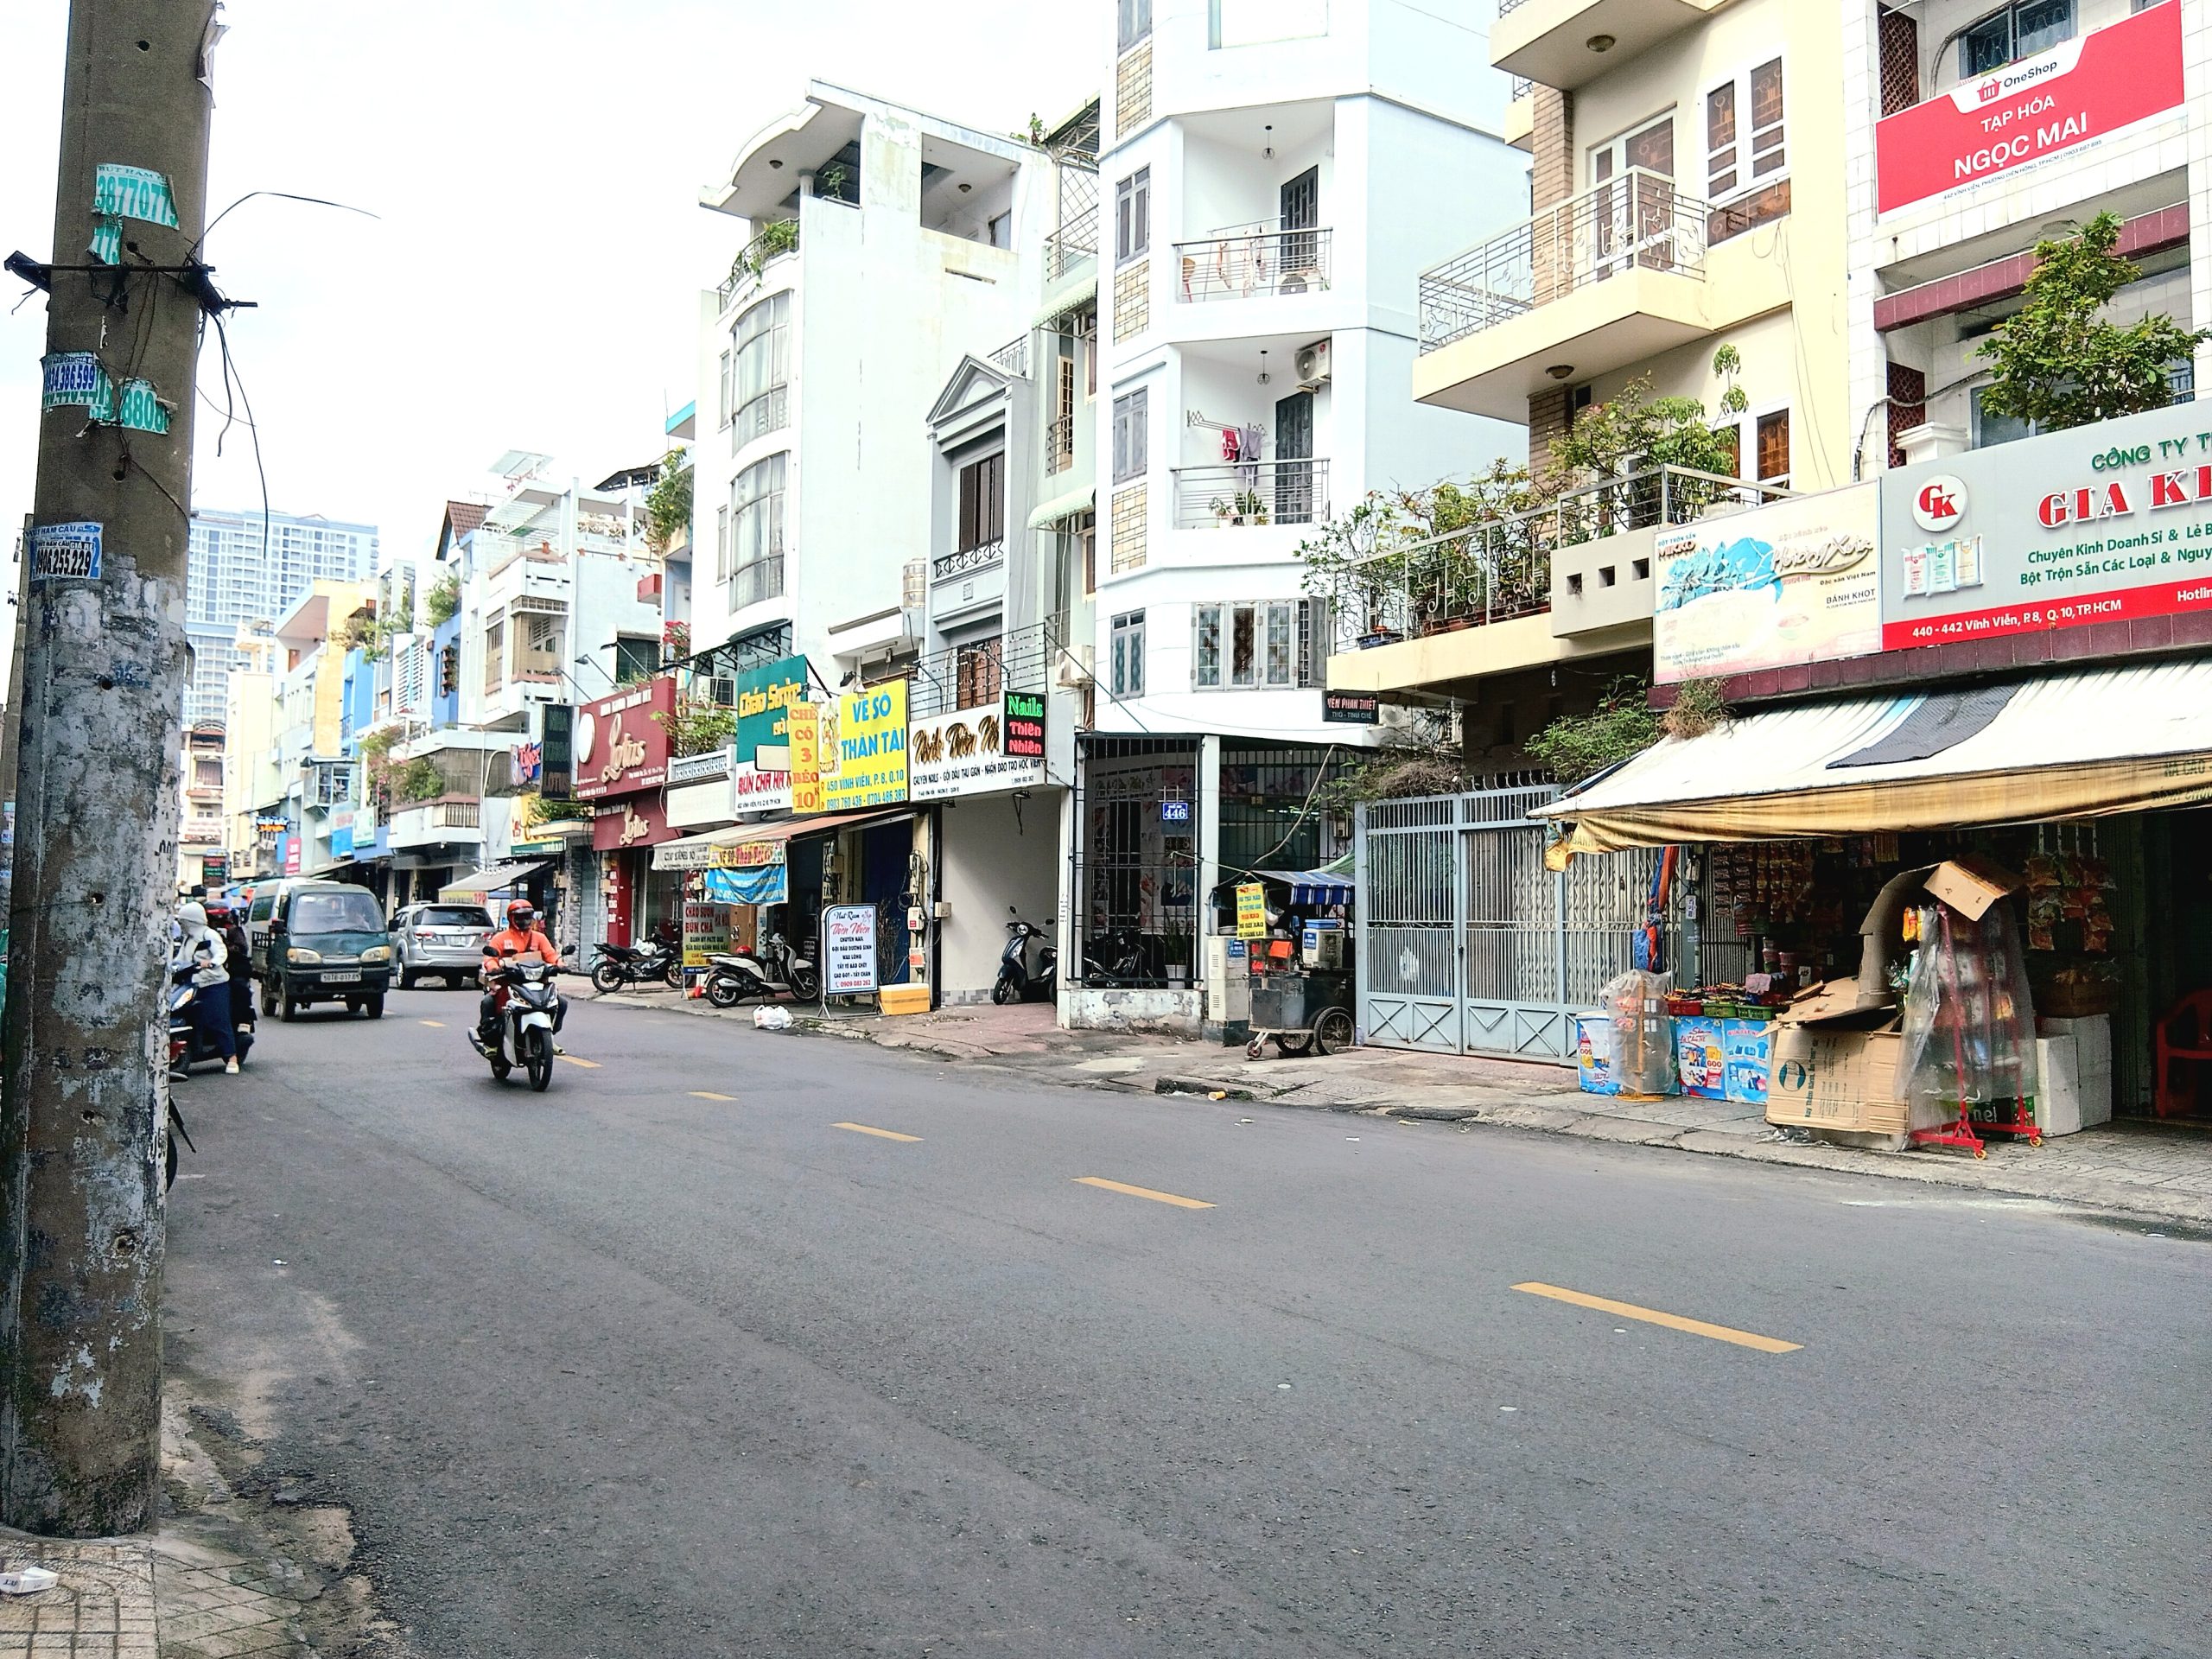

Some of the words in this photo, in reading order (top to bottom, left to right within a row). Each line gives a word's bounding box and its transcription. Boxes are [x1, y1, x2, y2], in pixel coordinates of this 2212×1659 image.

[2004, 61, 2057, 87] OneShop
[1980, 111, 2013, 133] TẠP
[2018, 95, 2056, 120] HÓA
[1954, 135, 2030, 179] NGỌC
[2037, 111, 2087, 149] MAI
[2091, 445, 2151, 471] CÔNG
[2158, 437, 2188, 457] TY
[1919, 484, 1958, 519] GK
[2037, 480, 2135, 528] GIA
[1657, 539, 1697, 559] MIKKO
[2028, 547, 2073, 563] Chuyên
[2076, 542, 2103, 556] Kinh
[2107, 534, 2149, 551] Doanh
[2187, 524, 2202, 538] Lẻ
[2020, 570, 2041, 586] Bột
[2046, 566, 2073, 582] Trộn
[2076, 561, 2099, 576] Sẵn
[2102, 558, 2125, 572] Các
[2129, 554, 2156, 569] Loại
[1825, 592, 1851, 605] BÁNH
[1912, 625, 1933, 639] 440
[1943, 621, 1962, 634] 442
[1965, 619, 1990, 631] Vĩnh
[739, 686, 767, 718] Cháo
[789, 705, 818, 721] CHÈ
[852, 696, 869, 723] VÉ
[872, 689, 892, 721] SỐ
[1007, 695, 1044, 718] Nails
[795, 728, 814, 741] CÔ
[841, 731, 878, 761] THẦN
[880, 726, 905, 754] TÀI
[1009, 721, 1042, 737] Thiên
[601, 713, 647, 783] Lotus
[800, 747, 812, 763] 3
[1008, 739, 1042, 754] Nhiên
[792, 769, 819, 785] BÉO
[620, 801, 650, 846] Lotus
[1165, 809, 1186, 819] 446
